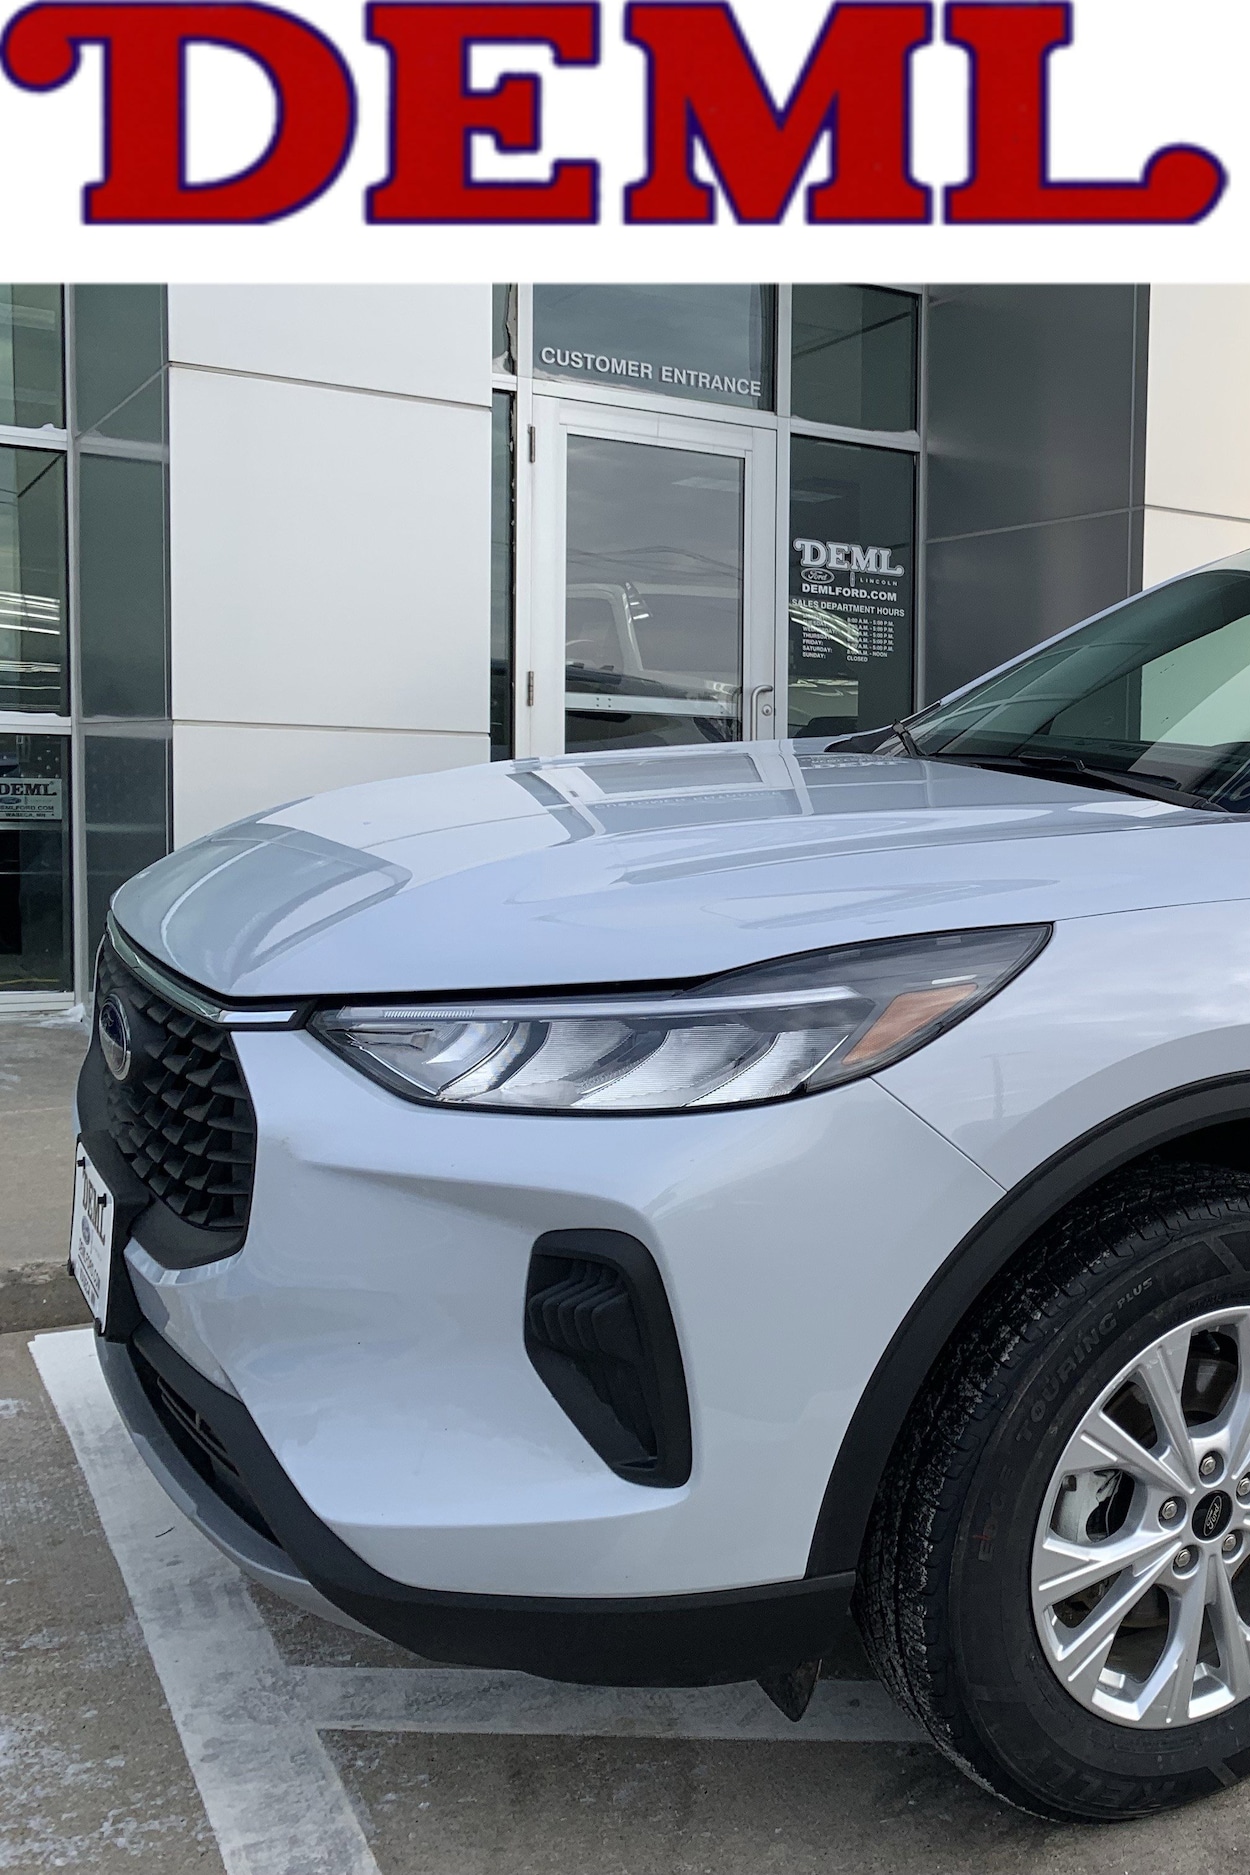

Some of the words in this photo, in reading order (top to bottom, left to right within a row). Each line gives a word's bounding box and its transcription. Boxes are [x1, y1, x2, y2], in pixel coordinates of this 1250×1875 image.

[541, 347, 653, 379] CUSTOMER
[661, 366, 762, 397] ENTRANCE
[793, 538, 905, 577] DEML
[802, 583, 897, 601] DEMLFORD.COM
[860, 577, 898, 587] LINCOLN
[791, 598, 819, 609] SALES
[821, 601, 876, 614] DEPARTMENT
[877, 607, 905, 617] HOURS
[1015, 1311, 1118, 1443] TOURING
[1116, 1277, 1154, 1311] PLUS
